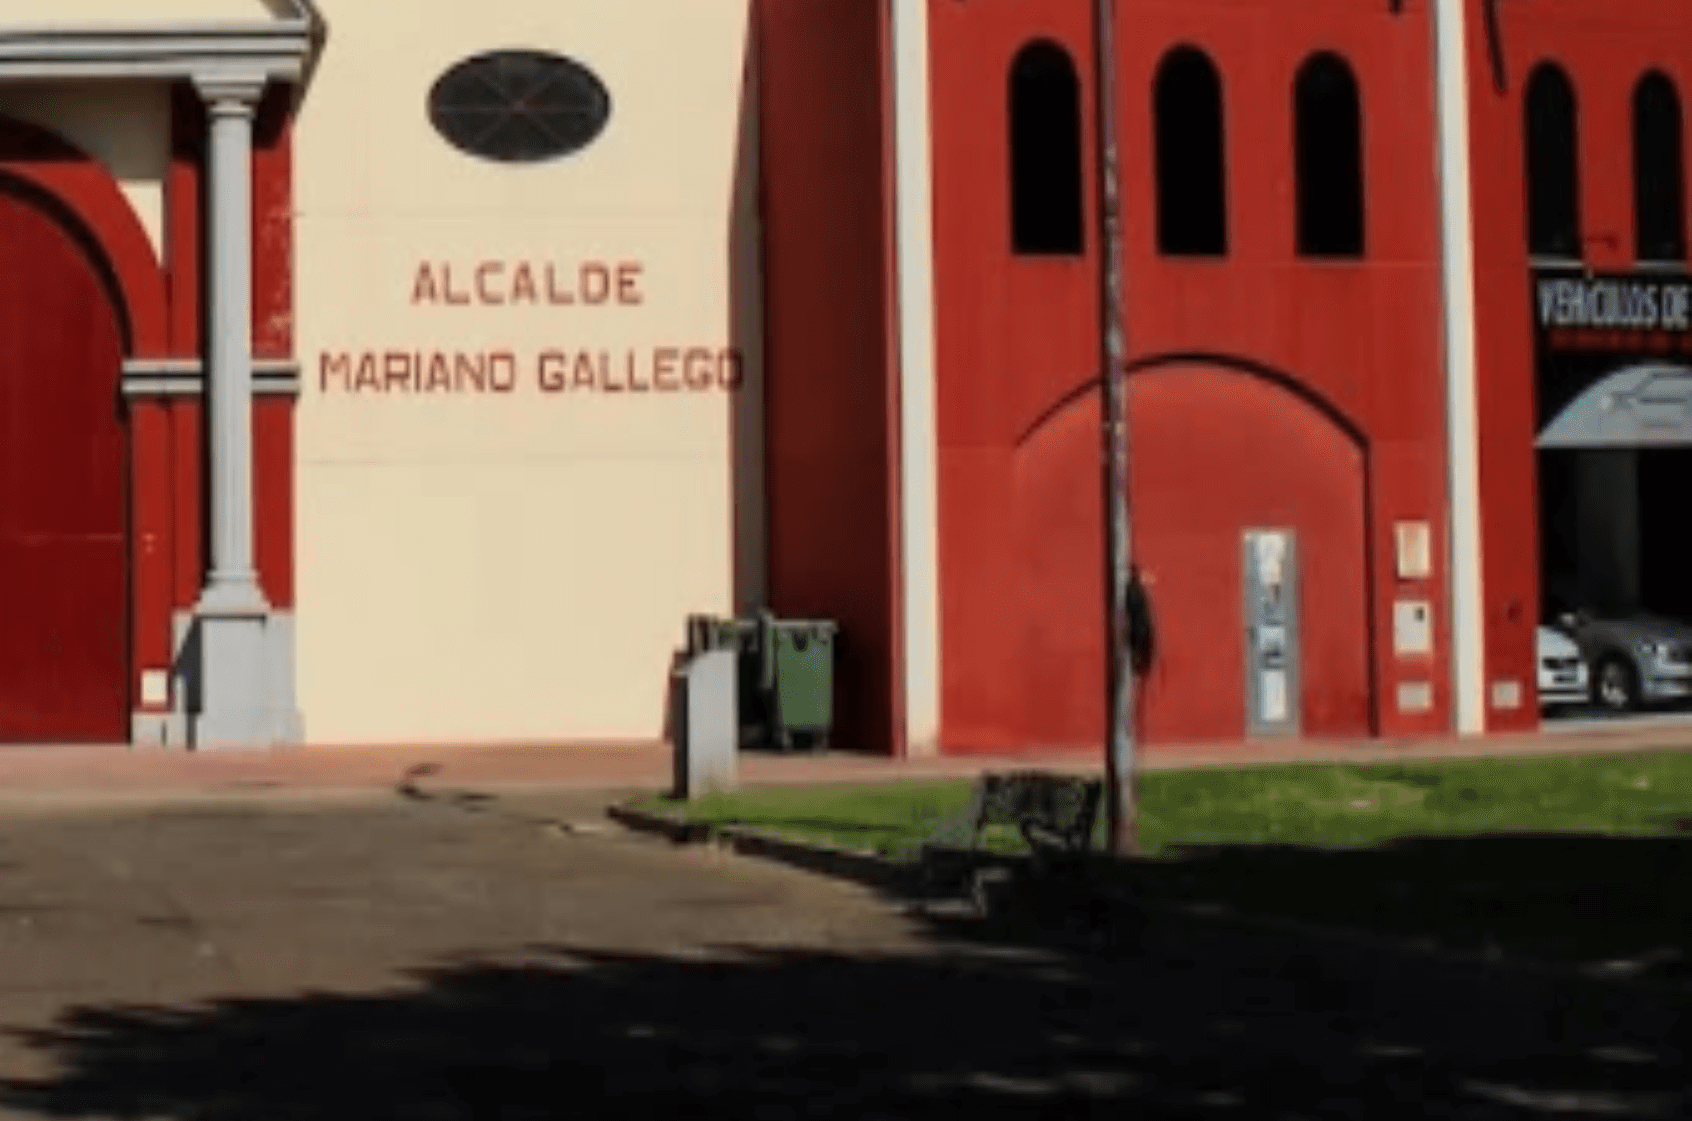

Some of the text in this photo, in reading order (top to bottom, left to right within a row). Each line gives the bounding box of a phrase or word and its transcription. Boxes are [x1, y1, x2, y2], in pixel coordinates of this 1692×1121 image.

[411, 259, 644, 306] ALCALDE
[319, 346, 745, 393] MARIANO GALLEGO
